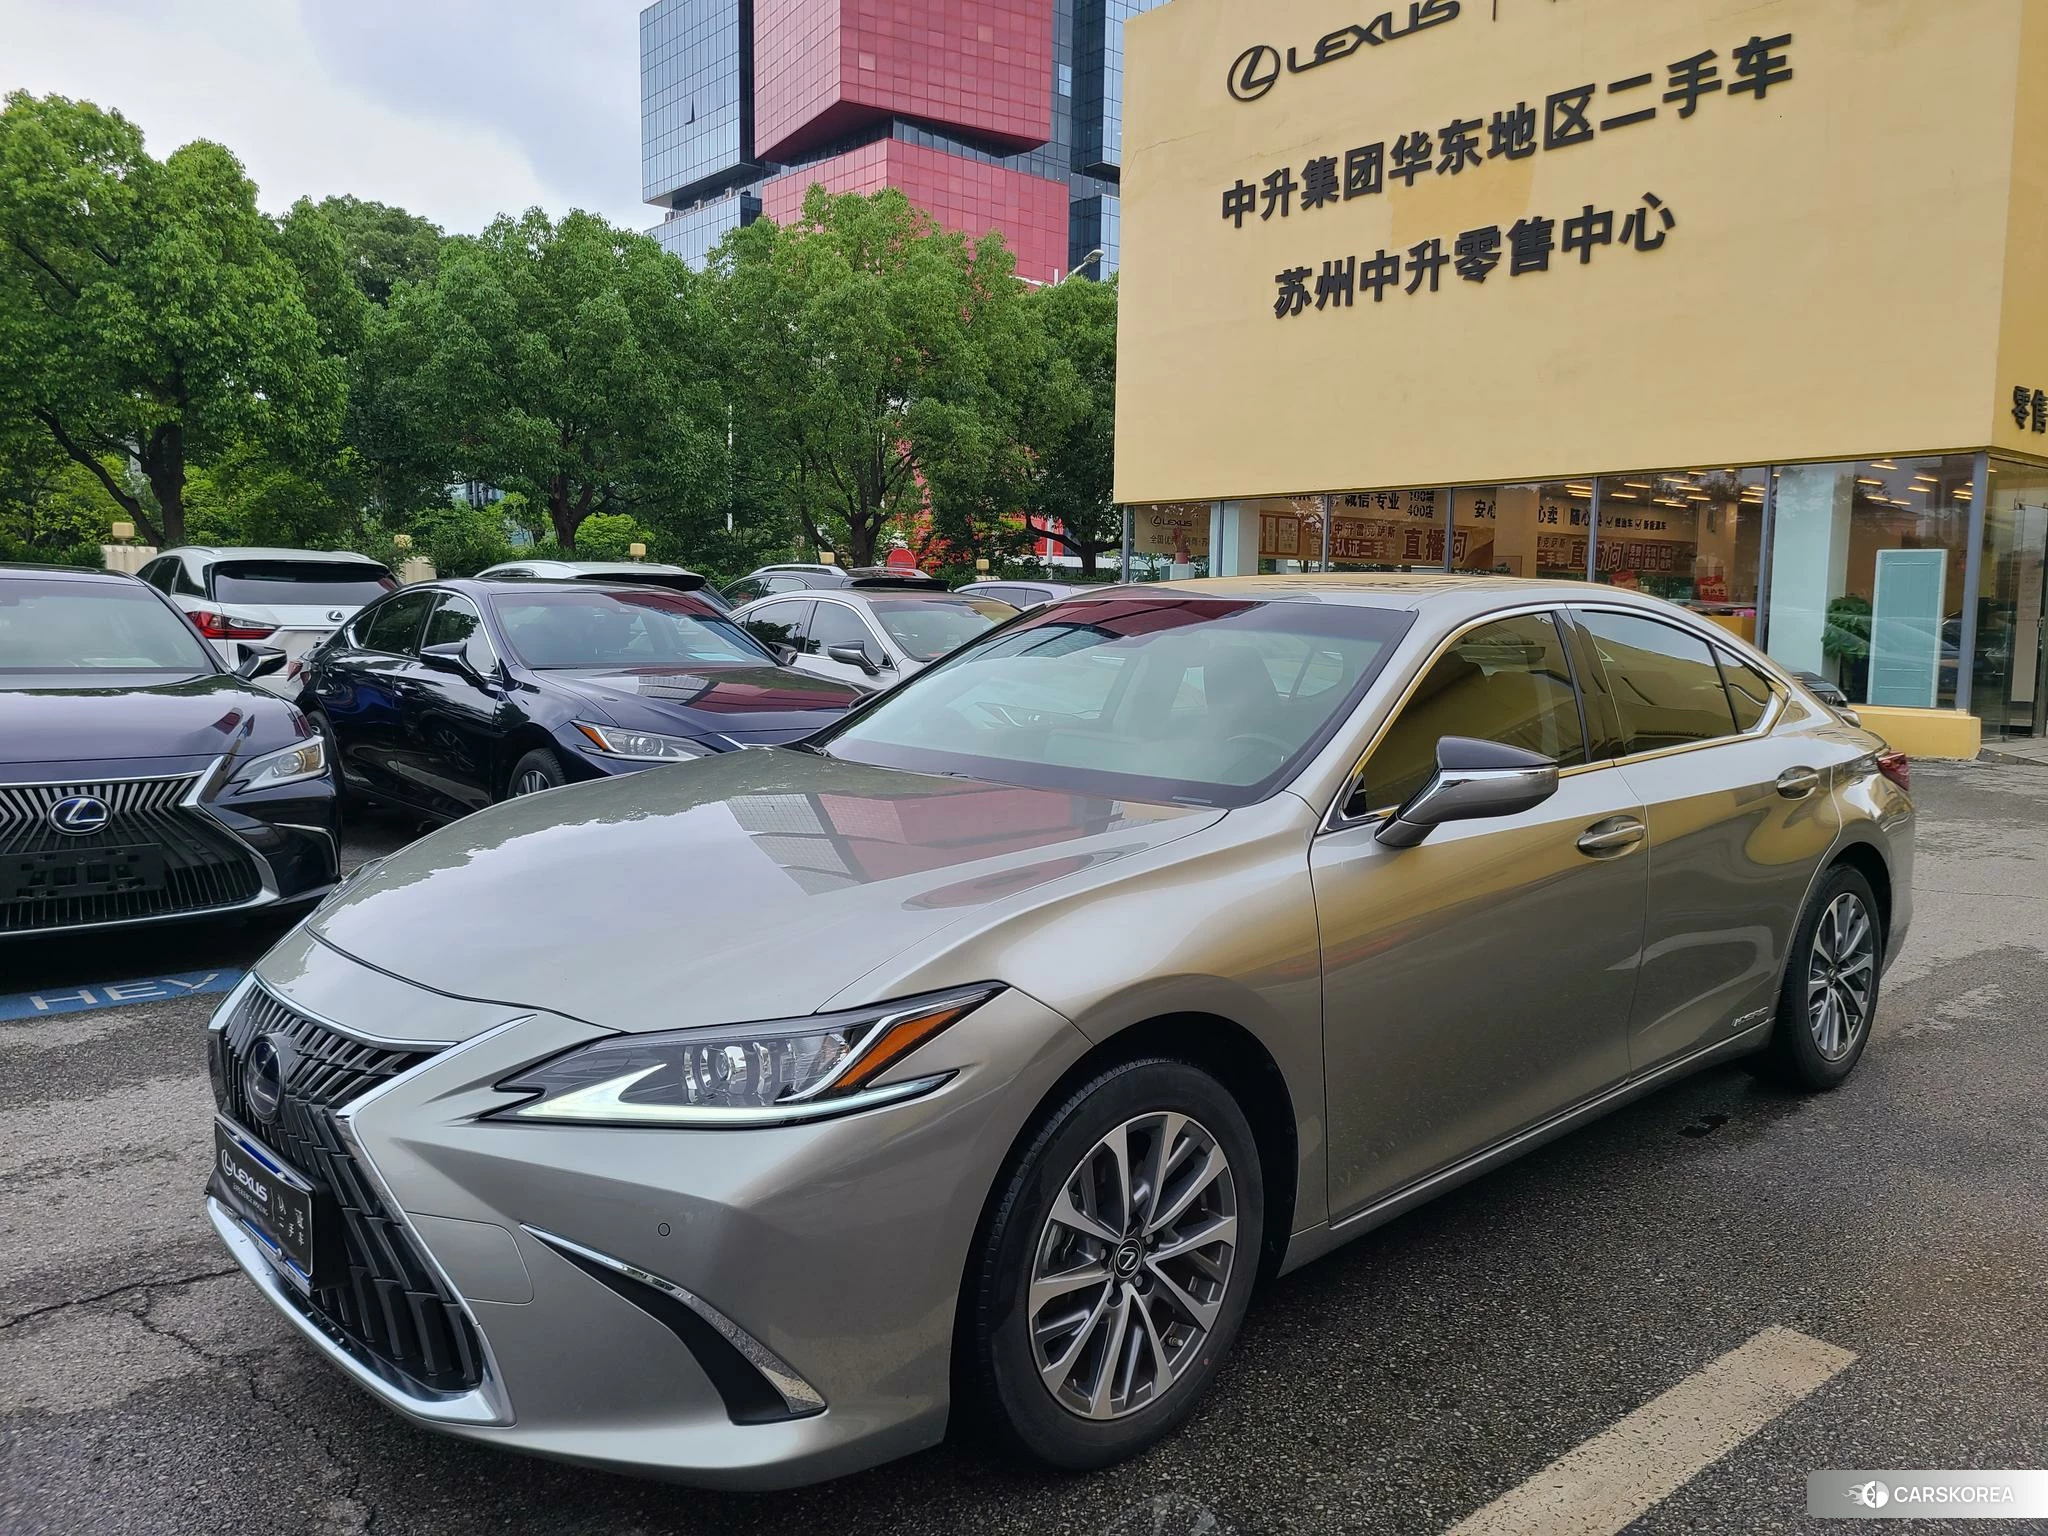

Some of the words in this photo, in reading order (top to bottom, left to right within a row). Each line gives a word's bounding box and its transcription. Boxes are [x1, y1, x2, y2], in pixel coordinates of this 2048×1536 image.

[1287, 0, 1460, 73] LEXUS
[1221, 32, 1793, 229] 中升集团华东地区二手车
[1272, 191, 1676, 320] 苏州中升零售中心
[1162, 518, 1193, 527] LEXUS
[232, 1164, 268, 1203] LEXUS
